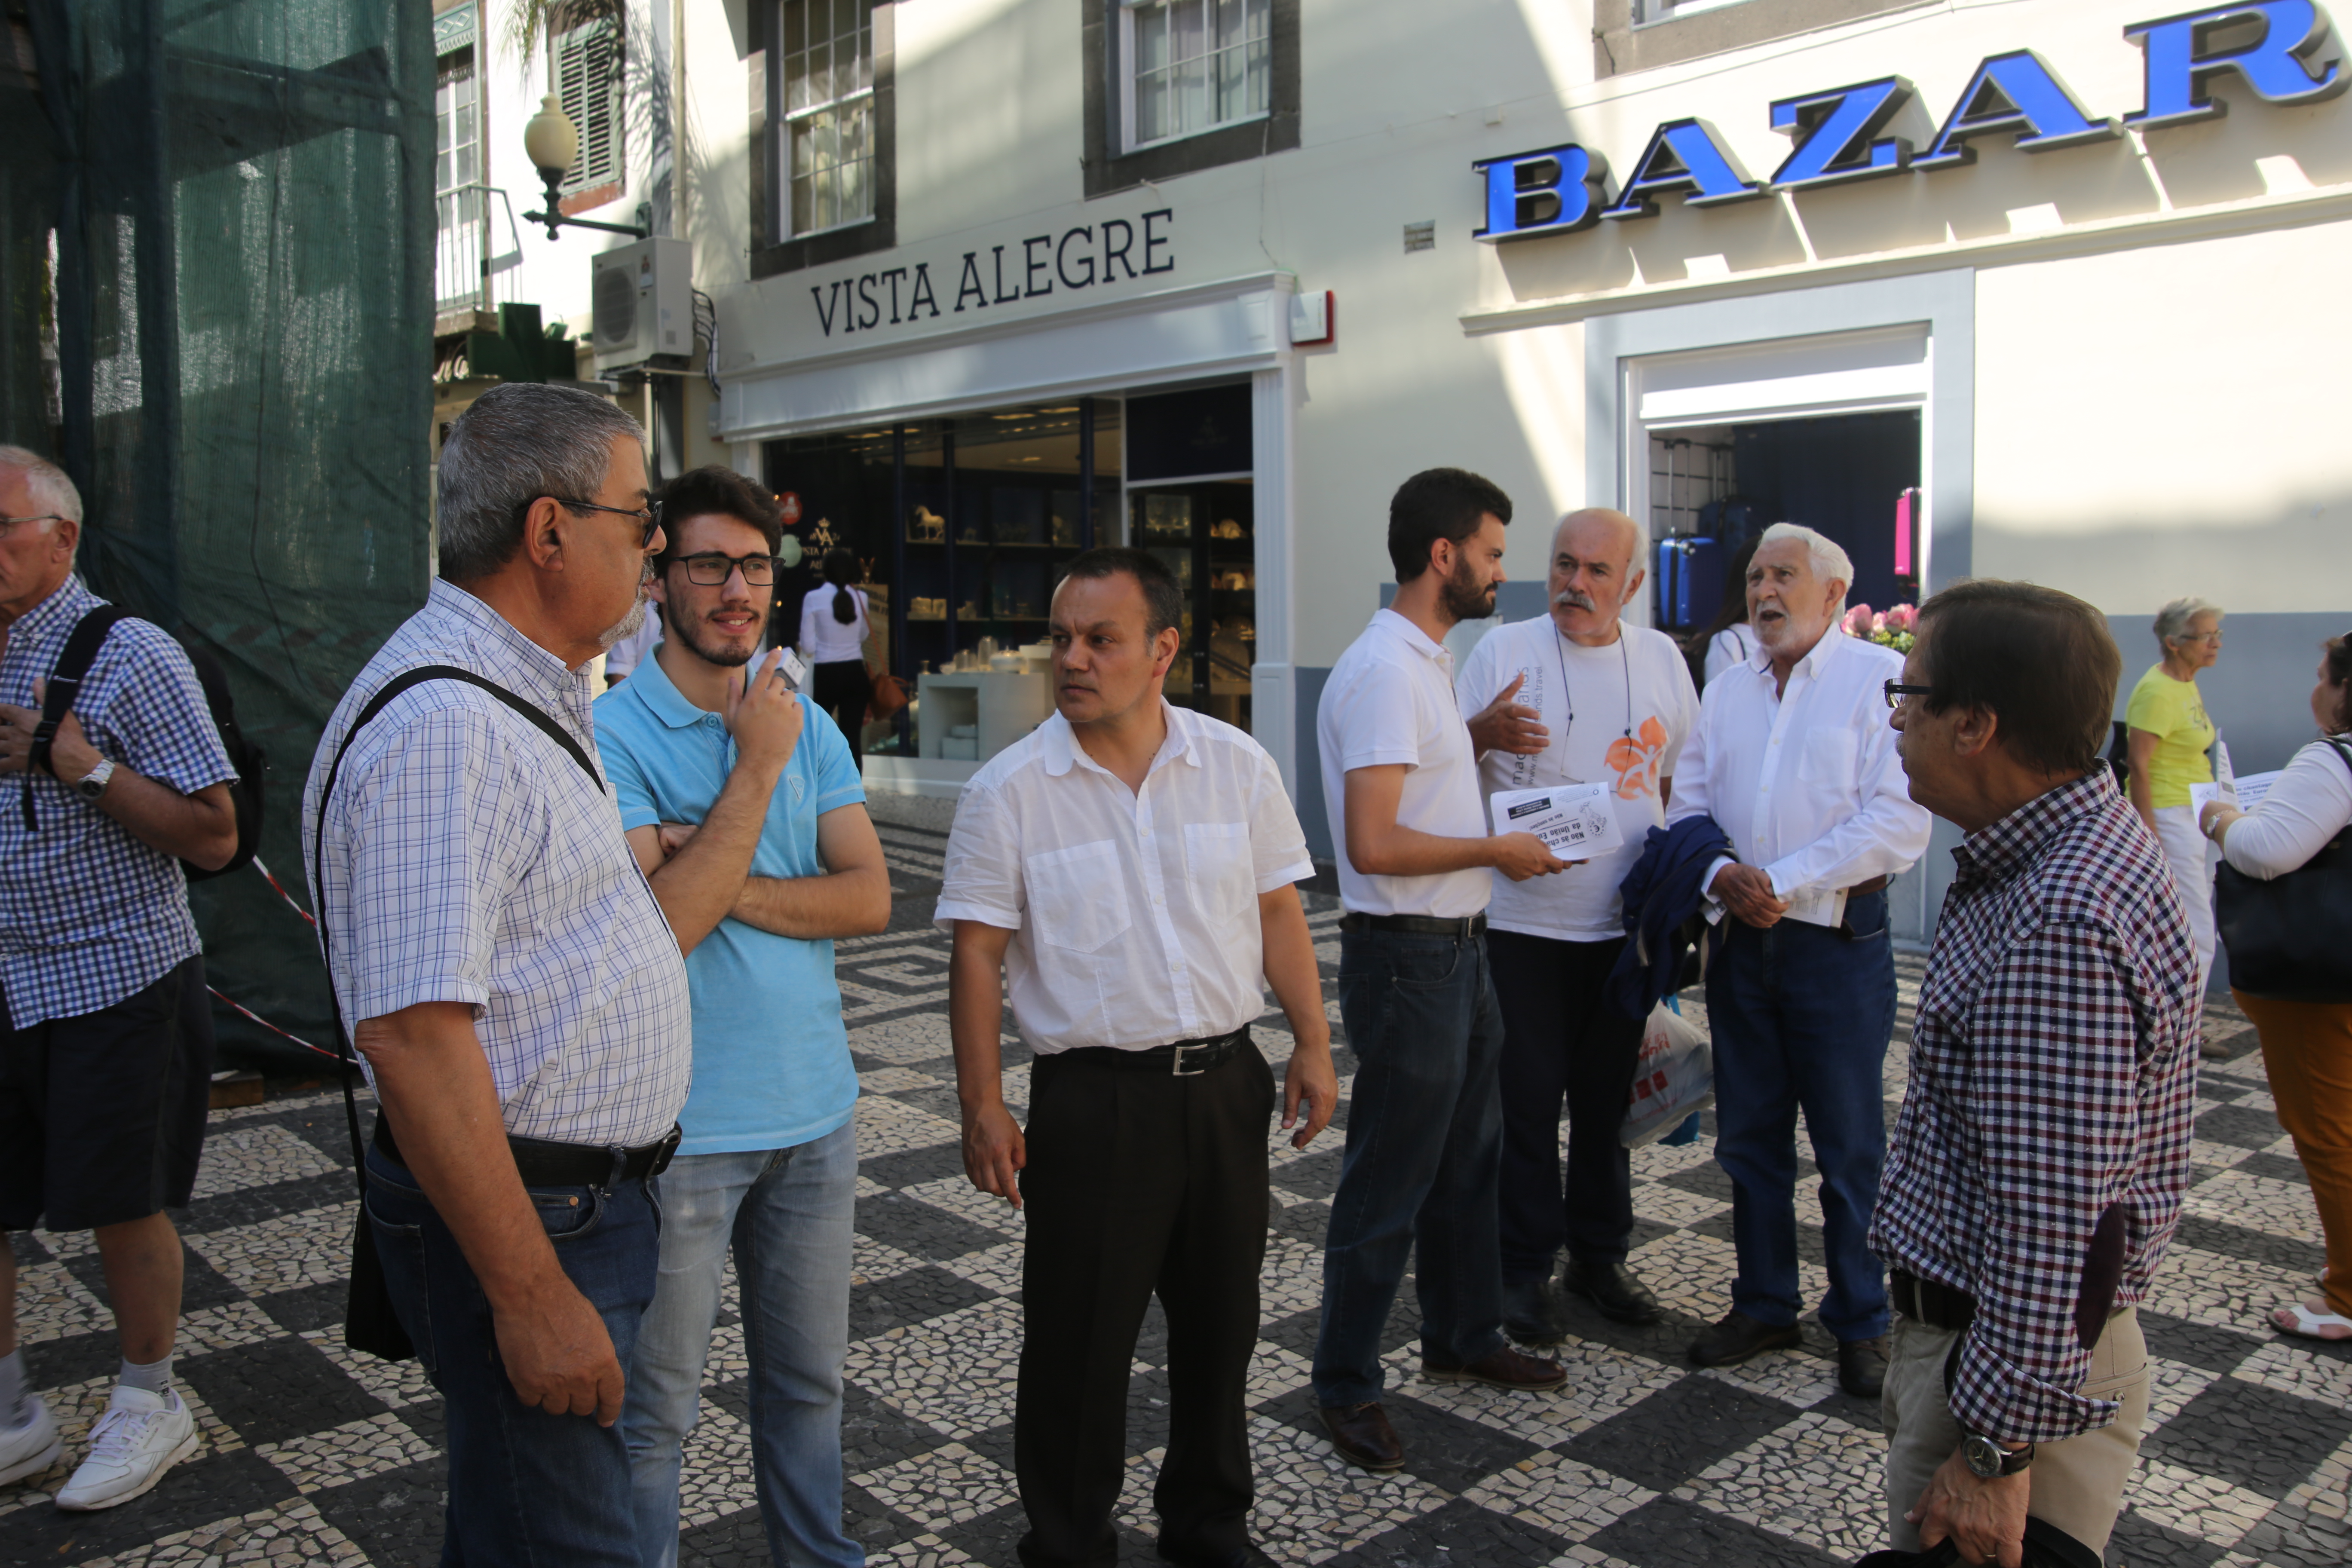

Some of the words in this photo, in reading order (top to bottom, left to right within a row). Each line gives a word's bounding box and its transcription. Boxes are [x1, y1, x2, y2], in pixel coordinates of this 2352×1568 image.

[1472, 0, 2352, 243] BAZAR
[811, 262, 940, 337] VISTA
[954, 208, 1175, 312] ALEGRE
[1550, 826, 1570, 836] União
[1571, 831, 1584, 839] Não
